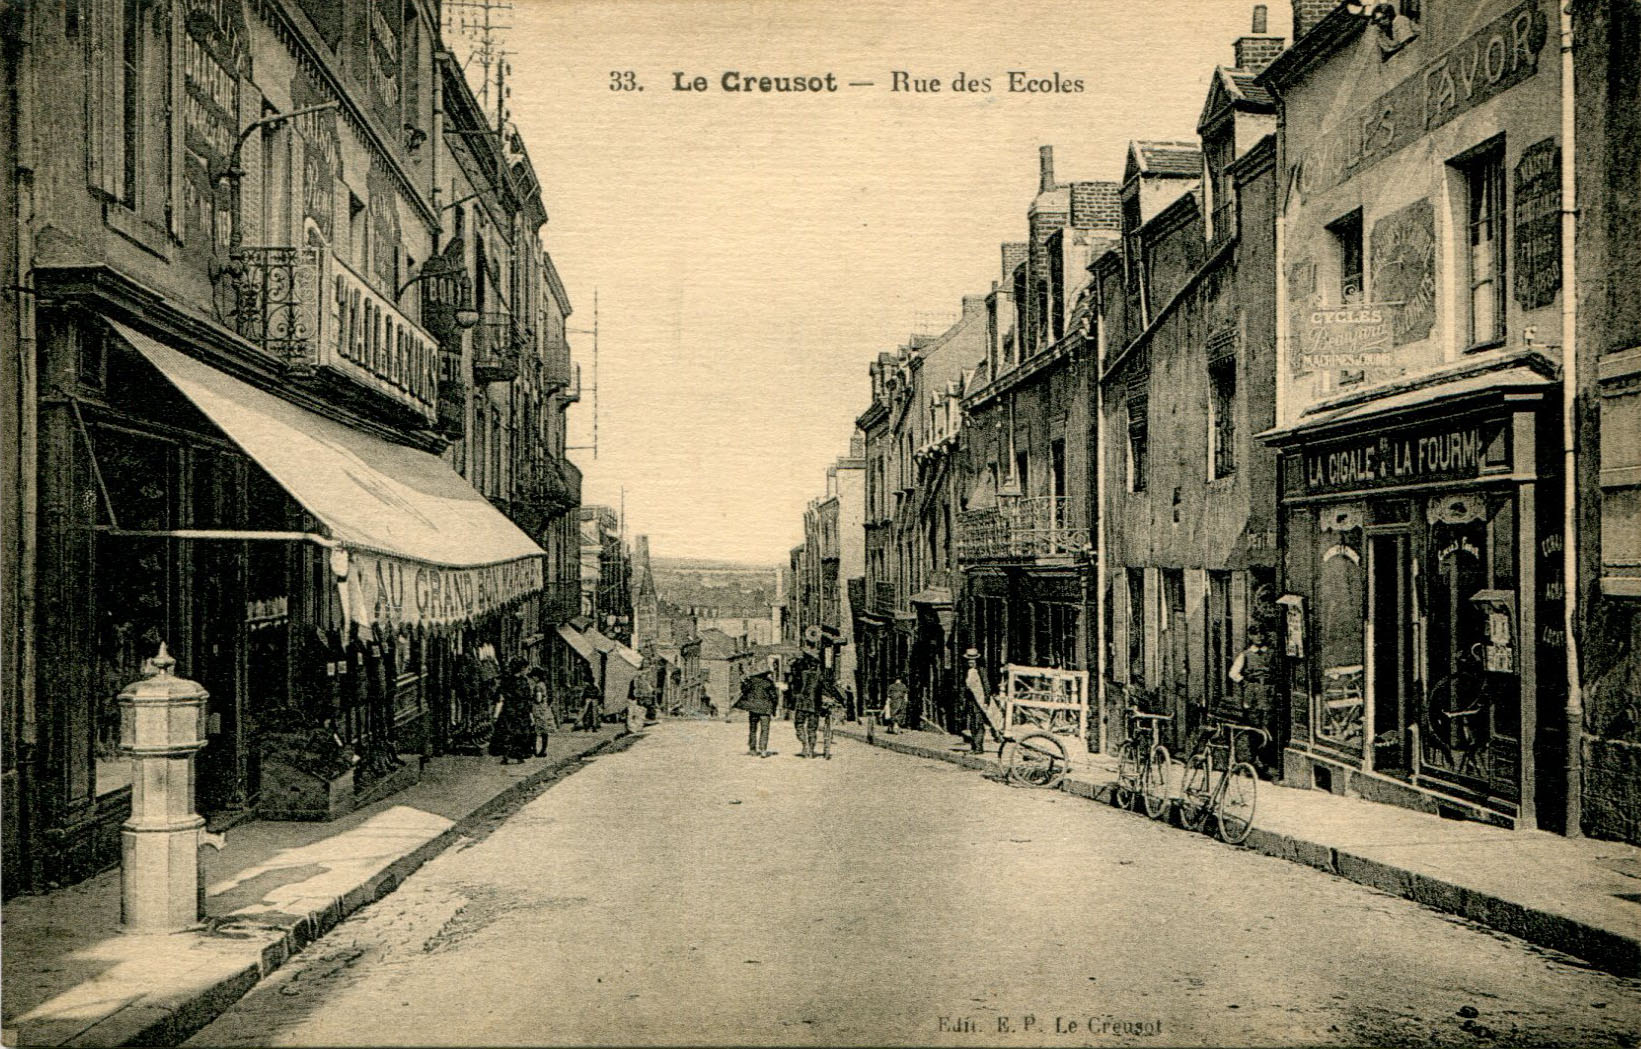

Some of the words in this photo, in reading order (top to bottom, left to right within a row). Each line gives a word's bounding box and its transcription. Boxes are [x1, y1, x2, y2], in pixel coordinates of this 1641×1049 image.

[1423, 10, 1536, 131] FAVOR
[1311, 309, 1382, 324] CYCLES
[1309, 456, 1324, 486] LA
[1328, 447, 1375, 485] CIGALE
[1394, 440, 1413, 476] LA
[375, 560, 403, 618] AU
[416, 567, 473, 619] GRAND
